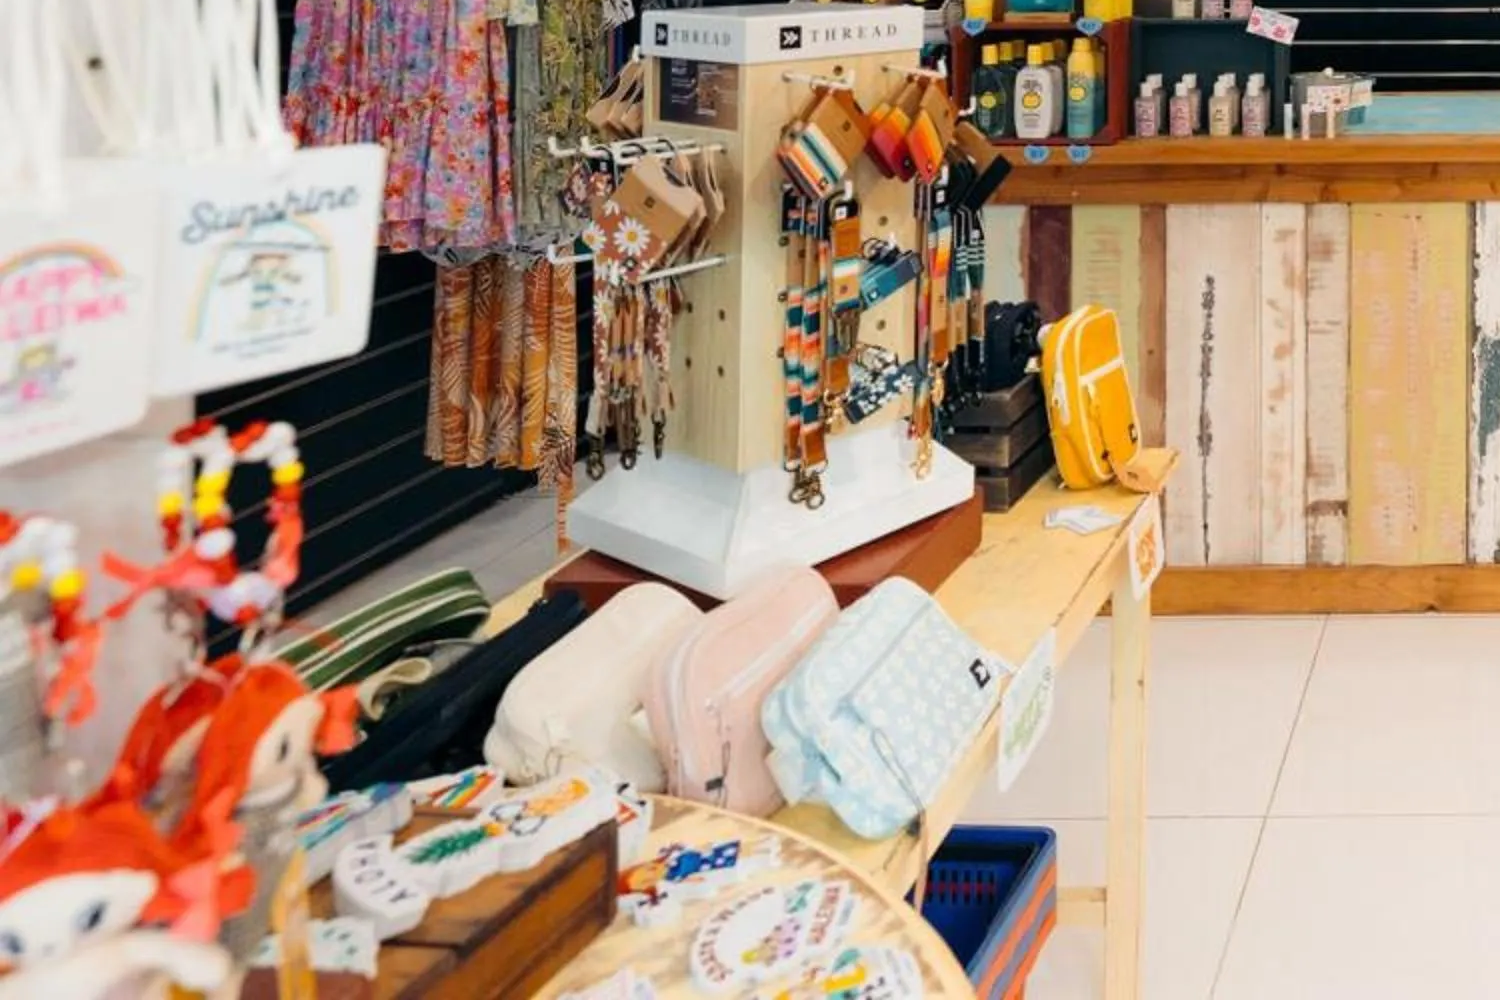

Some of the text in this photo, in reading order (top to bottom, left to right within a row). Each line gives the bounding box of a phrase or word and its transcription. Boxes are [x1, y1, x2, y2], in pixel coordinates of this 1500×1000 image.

[671, 27, 732, 48] THREAD
[810, 23, 898, 44] THREAD
[181, 186, 359, 243] Sunshine
